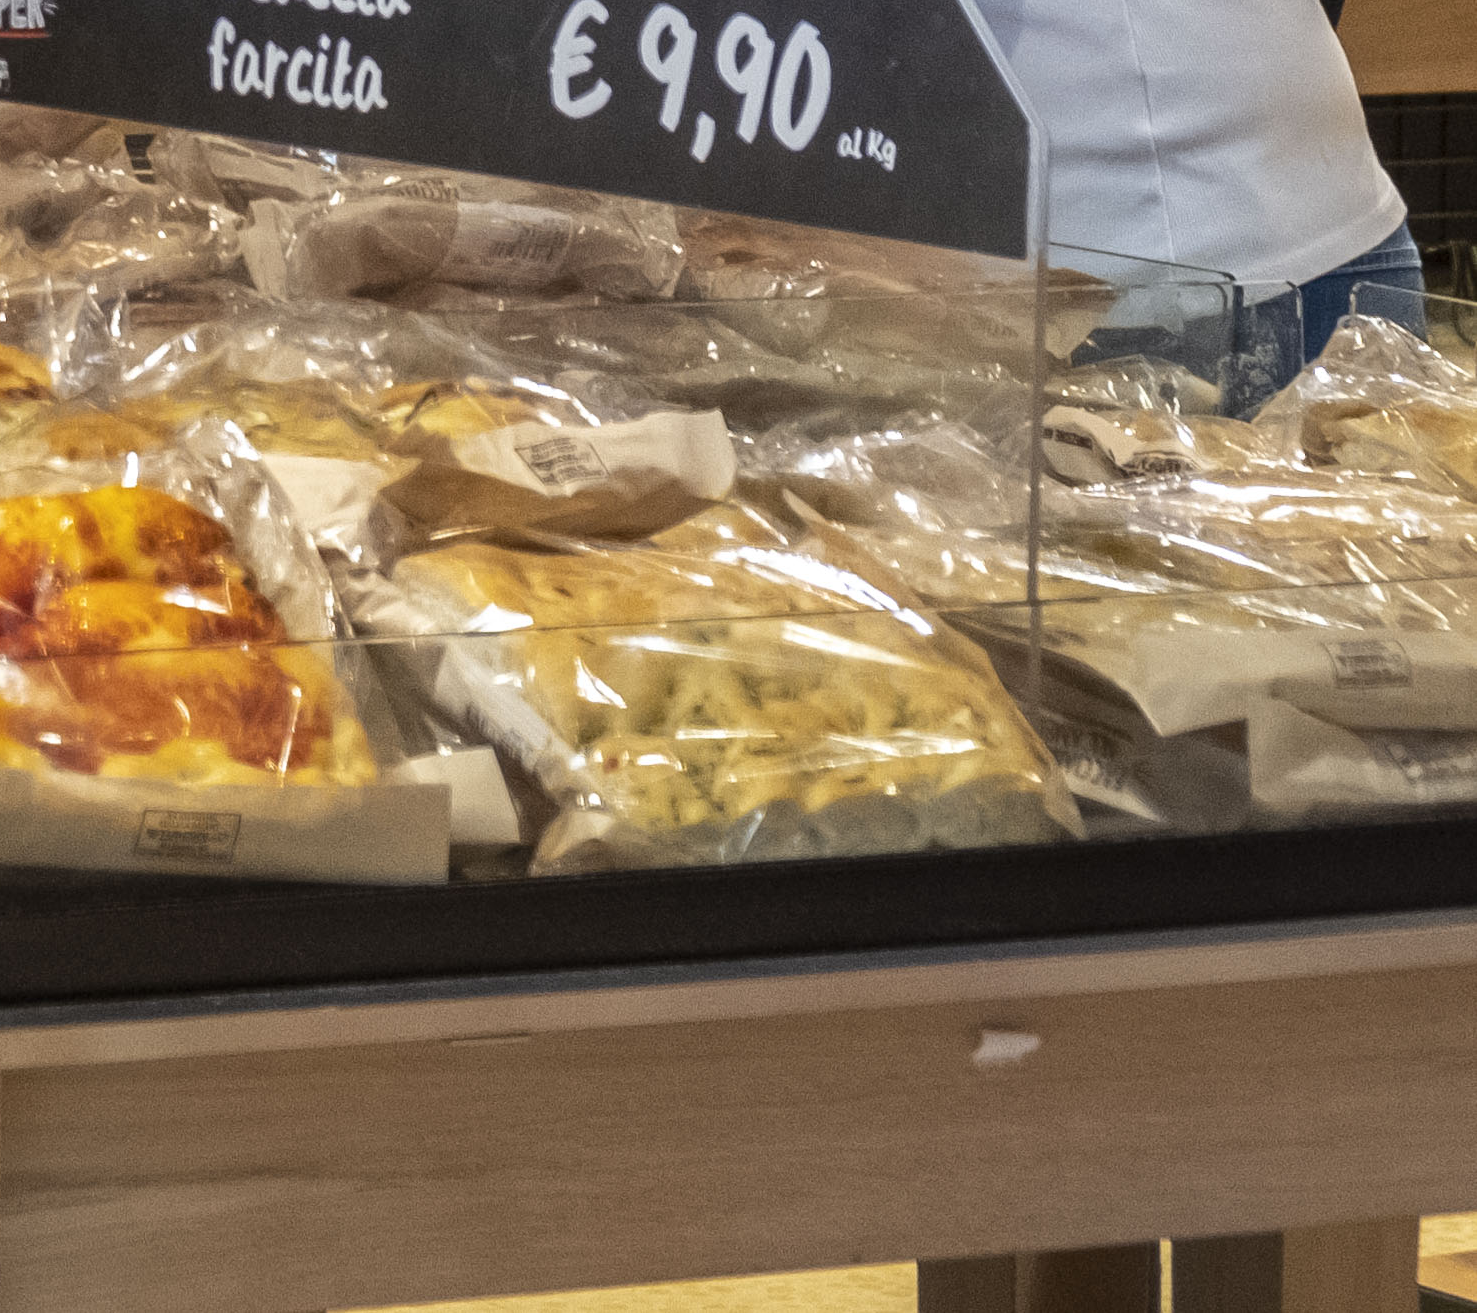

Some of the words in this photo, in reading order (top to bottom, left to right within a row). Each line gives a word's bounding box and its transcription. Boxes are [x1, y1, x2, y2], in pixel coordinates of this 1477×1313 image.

[206, 16, 388, 112] farcita
[638, 0, 832, 165] 9,90
[837, 128, 863, 162] al
[865, 127, 899, 172] Kg
